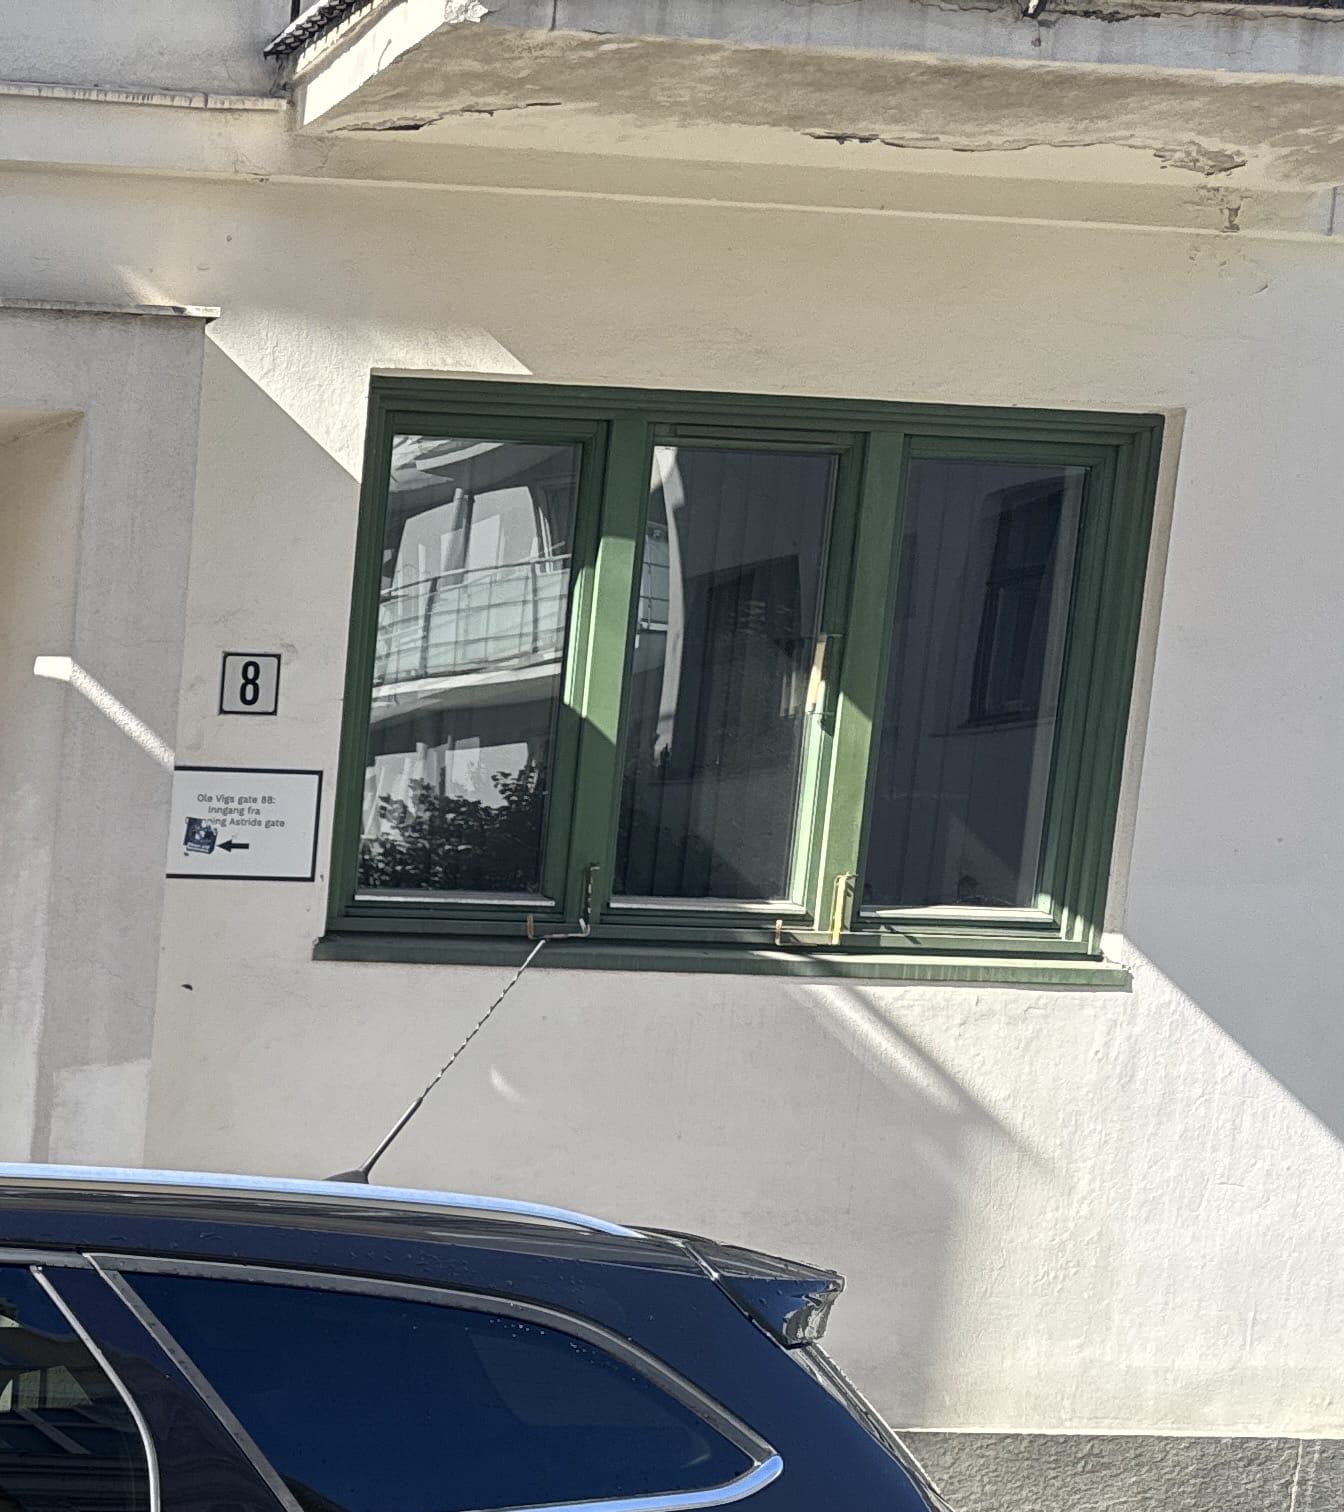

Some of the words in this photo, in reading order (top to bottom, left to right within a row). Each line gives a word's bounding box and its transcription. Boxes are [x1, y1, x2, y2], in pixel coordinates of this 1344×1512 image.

[239, 660, 261, 706] 8
[197, 793, 213, 803] Ole
[238, 795, 258, 805] gate
[208, 806, 244, 817] Inngang
[248, 806, 261, 815] fra
[264, 819, 286, 829] gate
